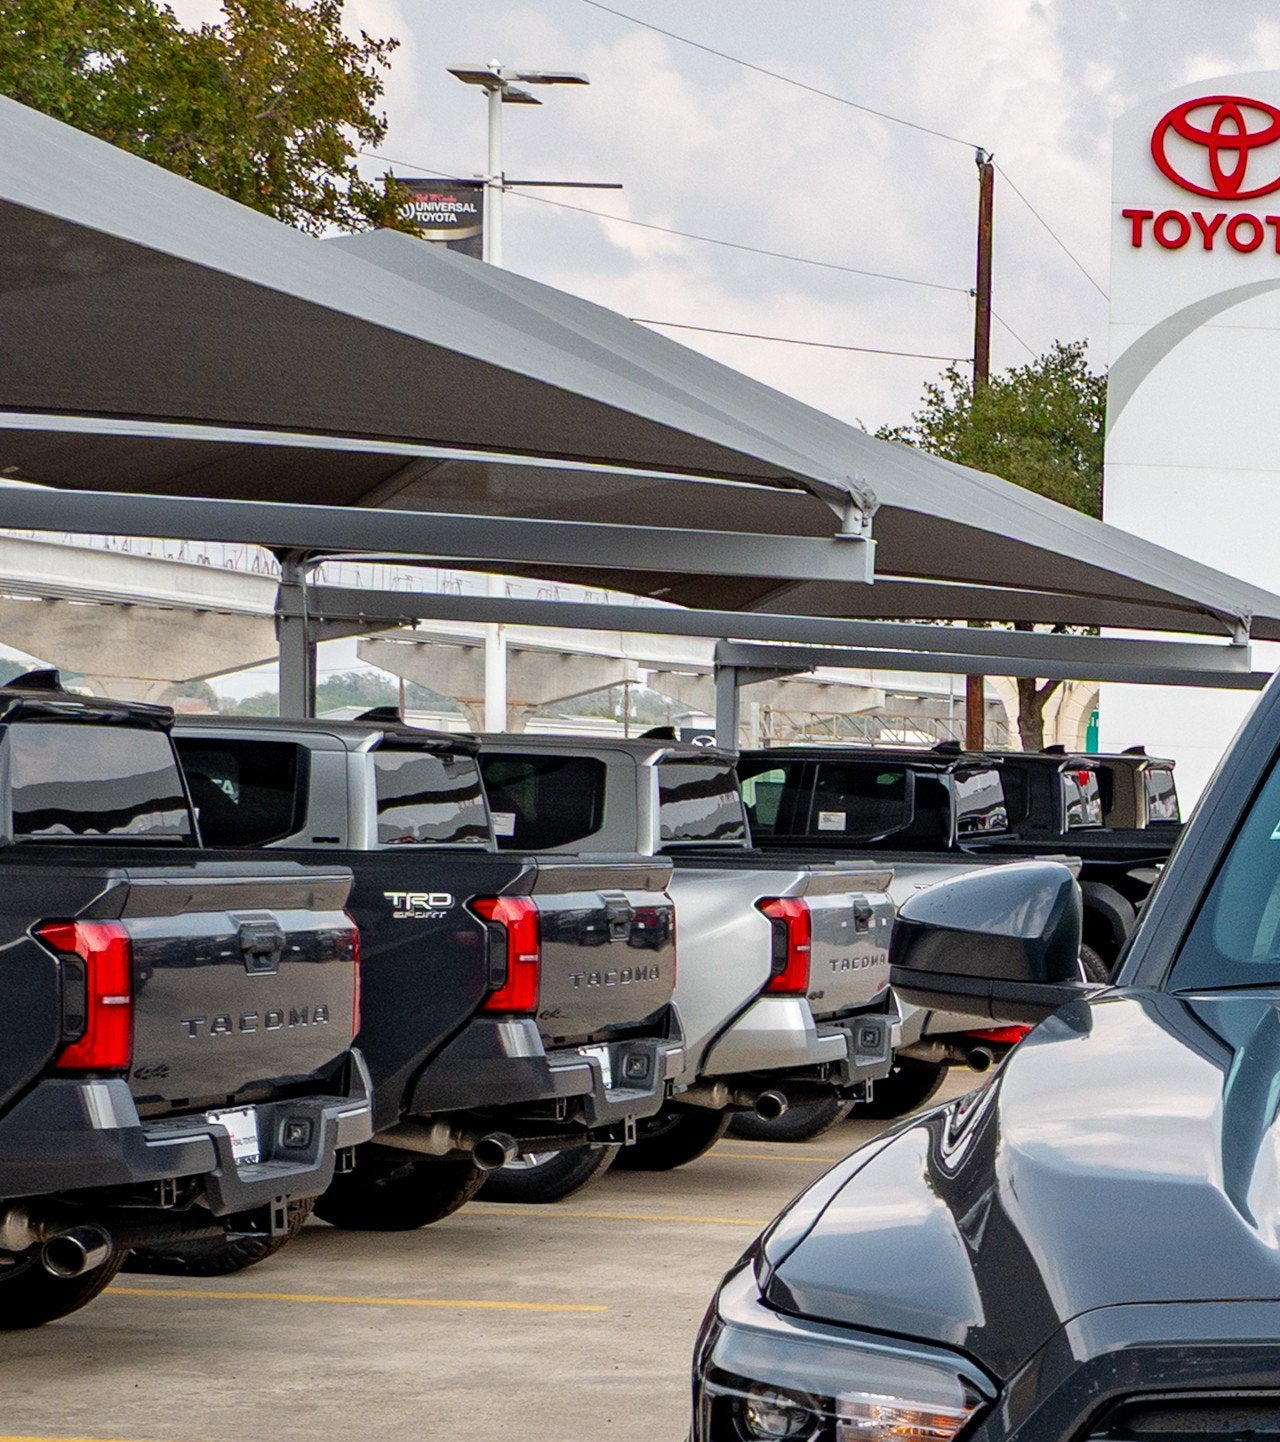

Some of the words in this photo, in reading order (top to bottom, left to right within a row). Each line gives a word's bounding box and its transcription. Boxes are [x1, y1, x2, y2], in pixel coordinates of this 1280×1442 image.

[415, 203, 477, 212] UNIVERSAL
[416, 212, 457, 222] TOYOTA
[383, 891, 454, 909] TRD
[829, 953, 886, 973] TACOMA
[569, 964, 659, 989] TACOMA
[180, 1004, 329, 1038] TACOMA
